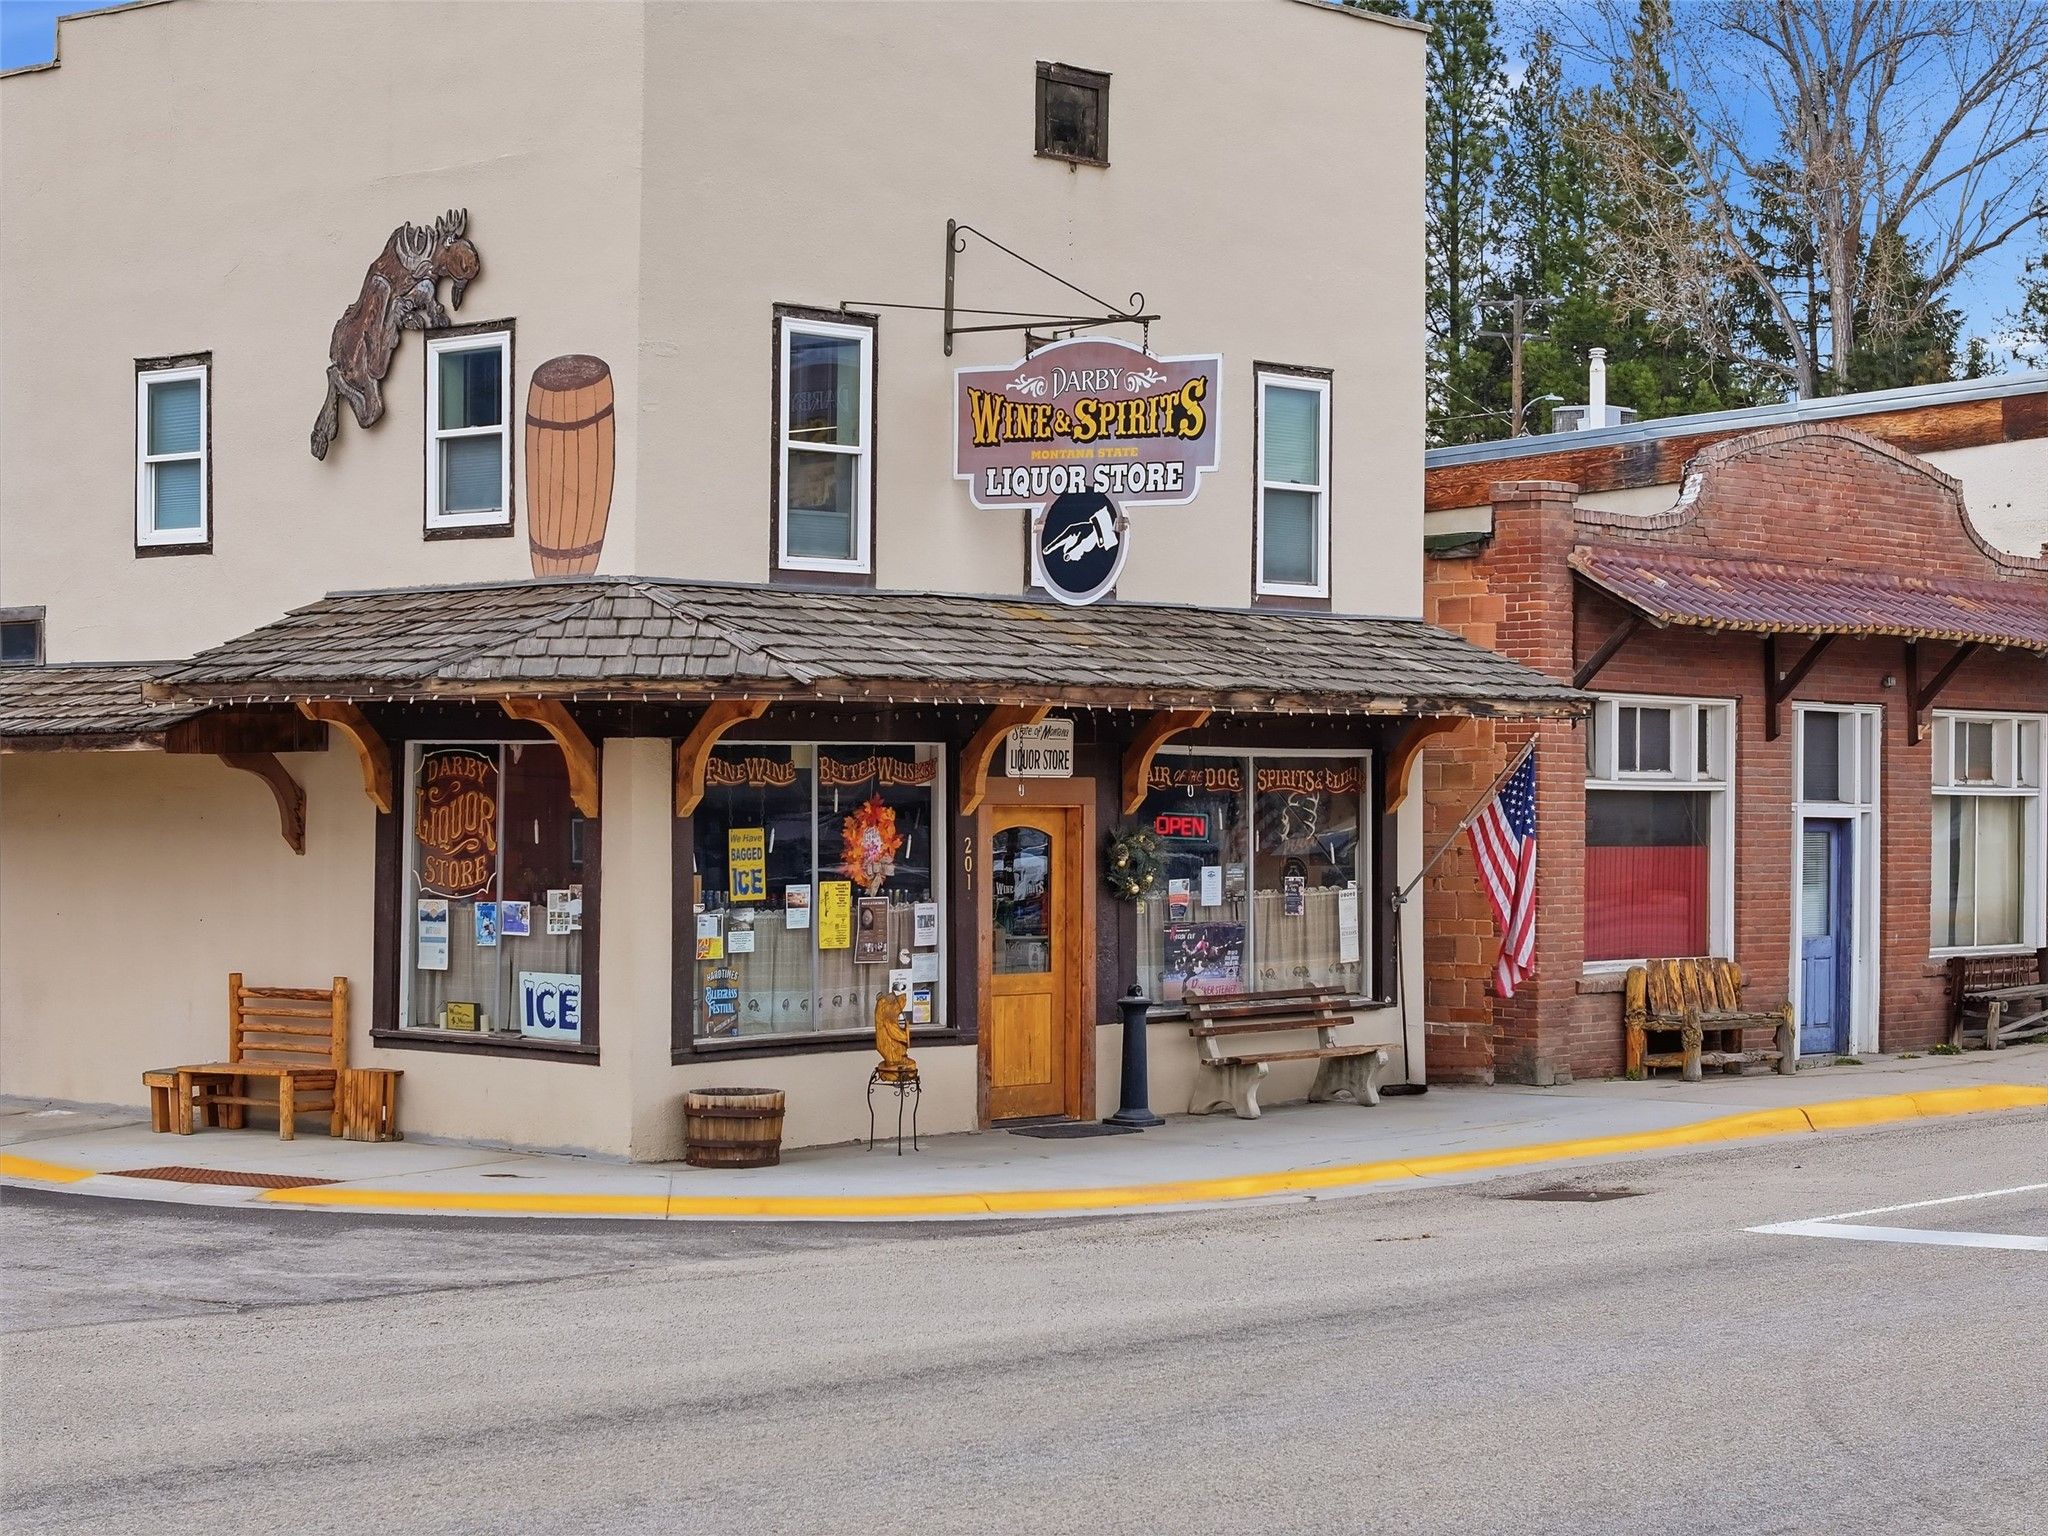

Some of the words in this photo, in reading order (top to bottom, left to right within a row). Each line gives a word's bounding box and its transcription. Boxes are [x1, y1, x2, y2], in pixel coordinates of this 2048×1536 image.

[1050, 366, 1124, 399] DARBY
[967, 386, 1053, 447] WINE
[1054, 407, 1072, 434] &
[1072, 375, 1207, 442] SPIRITS
[1030, 447, 1094, 461] MONTANA
[1097, 447, 1139, 458] STATE
[985, 464, 1087, 498] LIQUOR
[1093, 461, 1185, 494] STORE
[1040, 725, 1069, 740] Montana
[427, 756, 488, 783] DARBY
[706, 758, 745, 780] FINE
[745, 758, 795, 780] WINE
[820, 756, 876, 780] BETTER
[1010, 749, 1040, 771] LIQUOR
[1043, 749, 1070, 770] STORE
[1147, 766, 1172, 786] AIR
[1204, 768, 1240, 787] DOG
[1257, 768, 1314, 791] SPIRITS
[1315, 771, 1323, 789] &
[416, 787, 496, 852] LIQUOR
[1155, 816, 1205, 836] OPEN
[730, 834, 741, 843] We
[743, 834, 763, 843] Have
[731, 847, 763, 861] BAGGED
[964, 837, 973, 890] 201
[424, 855, 487, 887] STORE
[732, 868, 764, 896] ICE
[524, 981, 579, 1030] ICE
